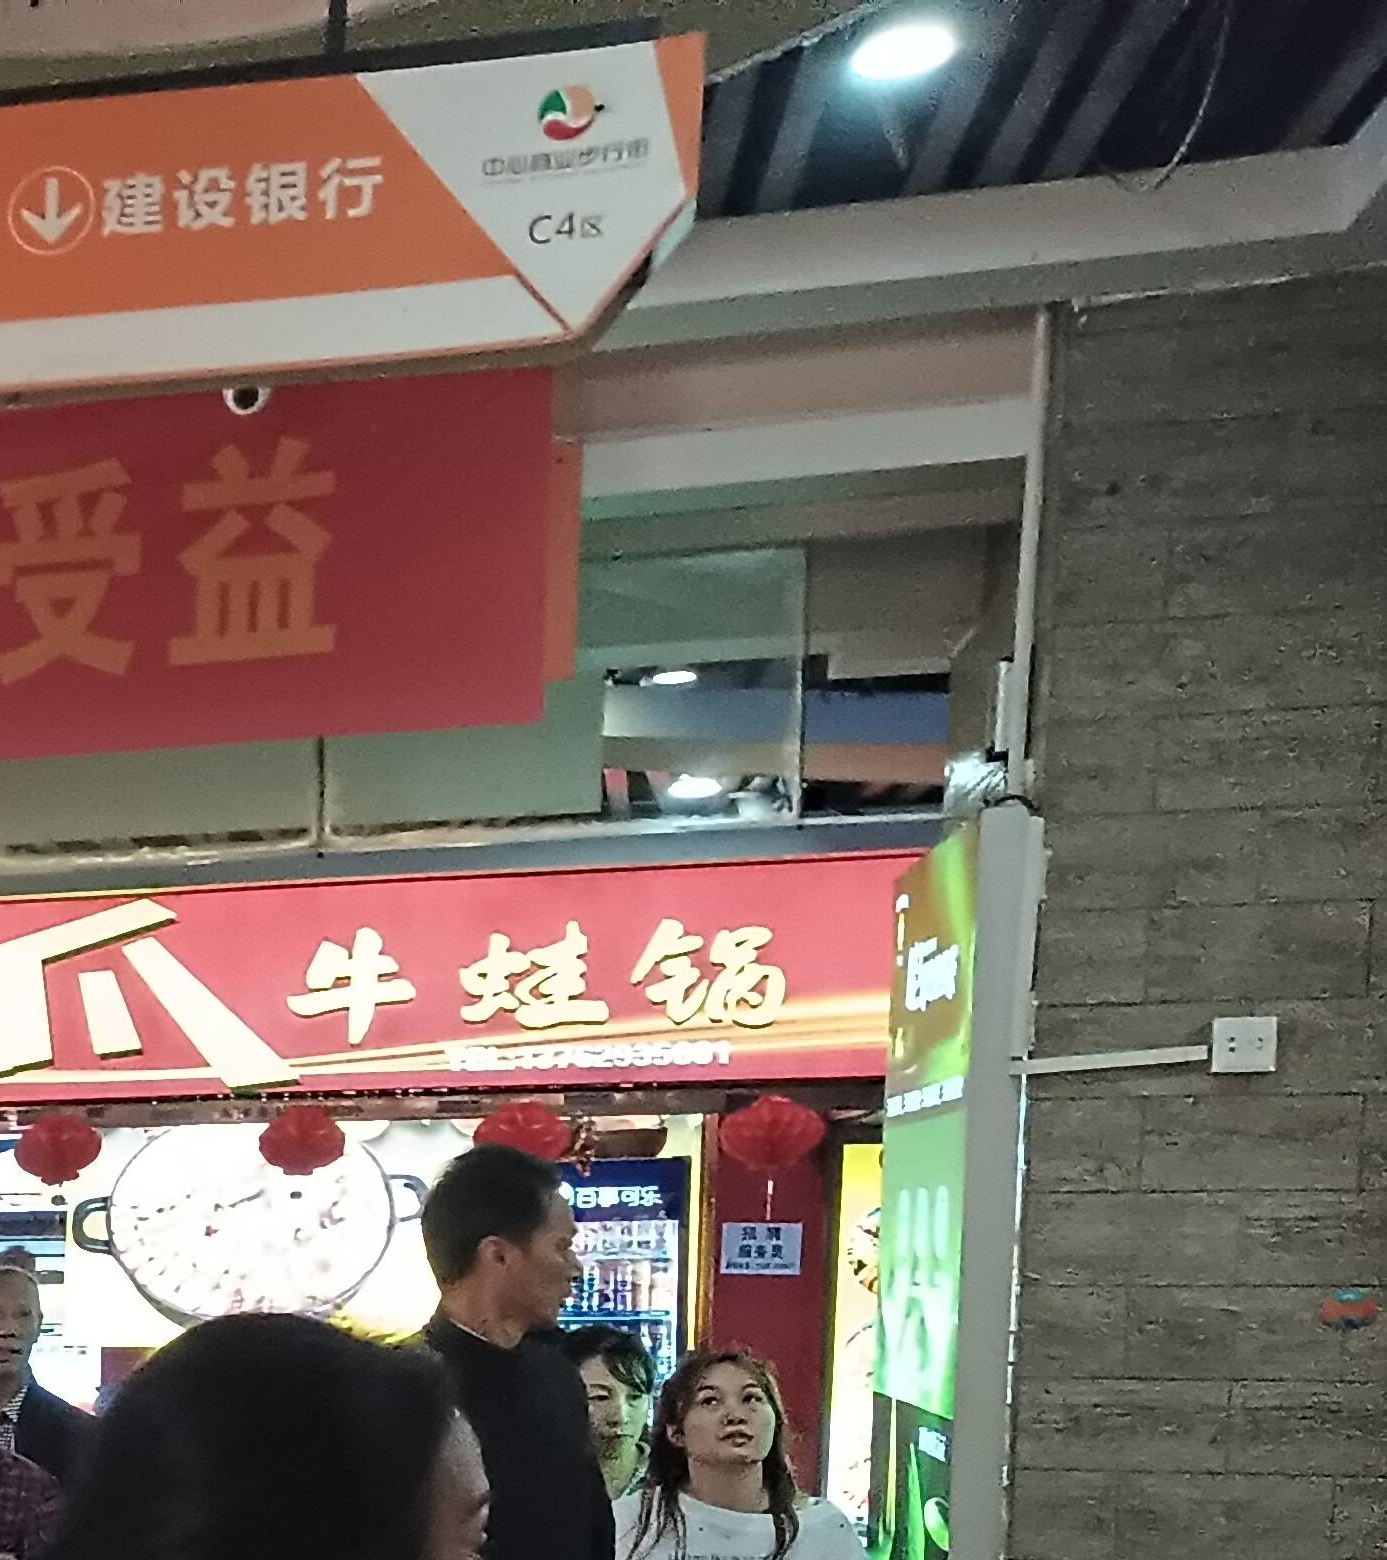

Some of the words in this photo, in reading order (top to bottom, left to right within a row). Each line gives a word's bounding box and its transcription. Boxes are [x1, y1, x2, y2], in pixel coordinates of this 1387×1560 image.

[102, 156, 384, 237] 建设银行
[529, 211, 604, 244] C4区
[287, 918, 787, 1045] 牛蛙锅
[574, 1185, 664, 1209] 百事可乐
